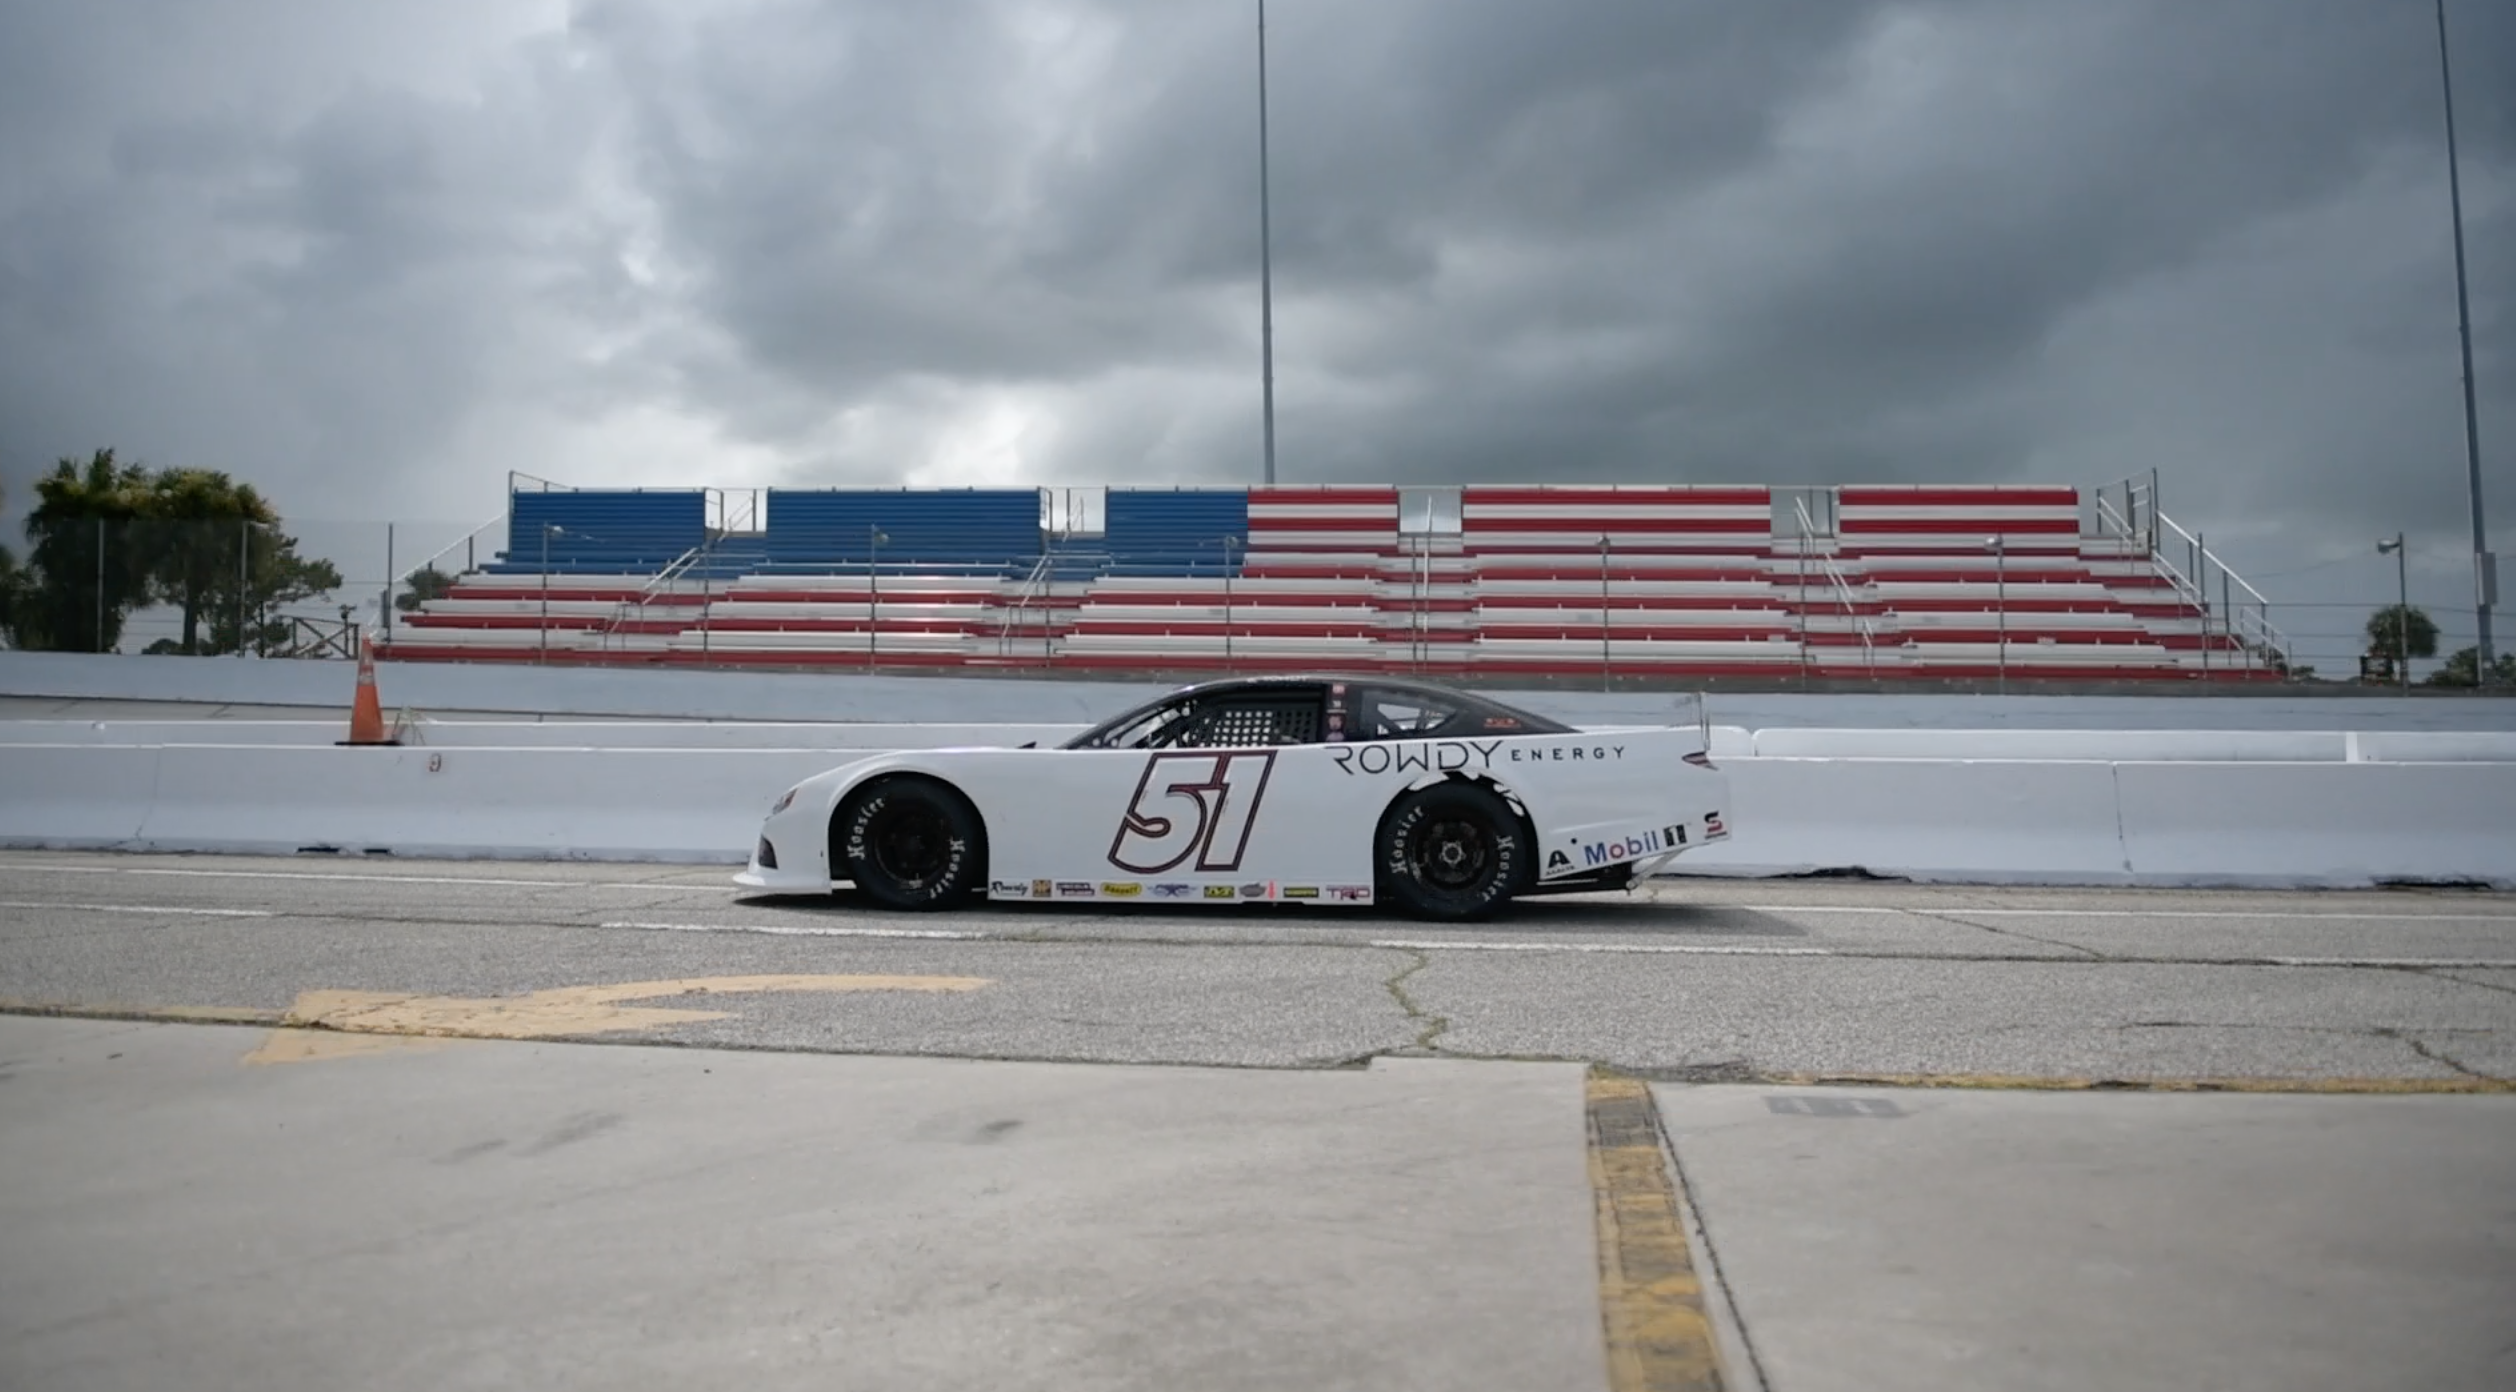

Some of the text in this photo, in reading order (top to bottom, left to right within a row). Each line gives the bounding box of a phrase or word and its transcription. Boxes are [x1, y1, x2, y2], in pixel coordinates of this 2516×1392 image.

[1324, 740, 1625, 775] ROWDY ENERGY
[1107, 749, 1279, 875] 51
[1583, 824, 1687, 867] Mobil 1
